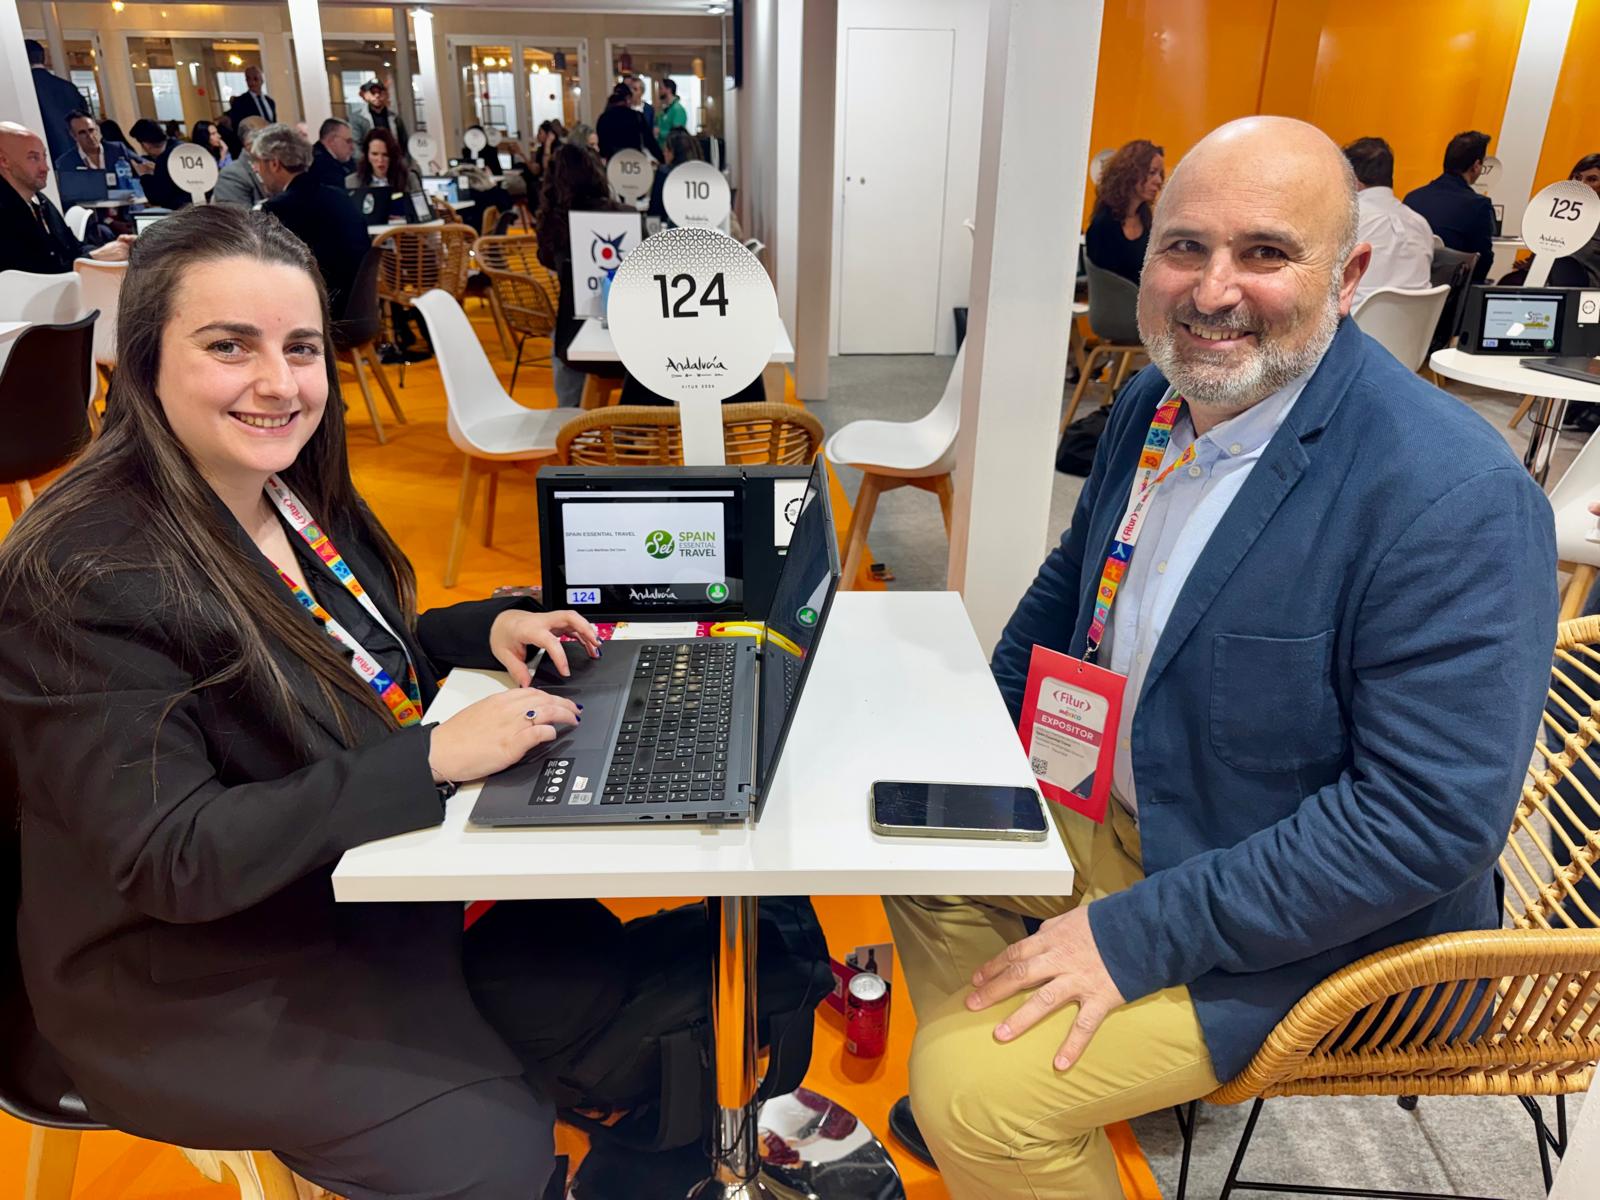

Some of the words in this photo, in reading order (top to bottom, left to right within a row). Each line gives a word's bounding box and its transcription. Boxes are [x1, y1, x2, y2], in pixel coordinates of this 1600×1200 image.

[180, 155, 204, 169] 104
[620, 160, 641, 175] 105
[684, 180, 710, 200] 110
[1549, 197, 1583, 221] 125
[653, 272, 729, 318] 124
[665, 355, 728, 372] Andalucía
[646, 531, 674, 555] Set
[679, 531, 716, 541] SPAIN
[680, 549, 717, 557] TRAVEL
[573, 591, 596, 602] 124
[1060, 691, 1085, 710] Fitur
[1041, 714, 1094, 740] EXPOSITOR
